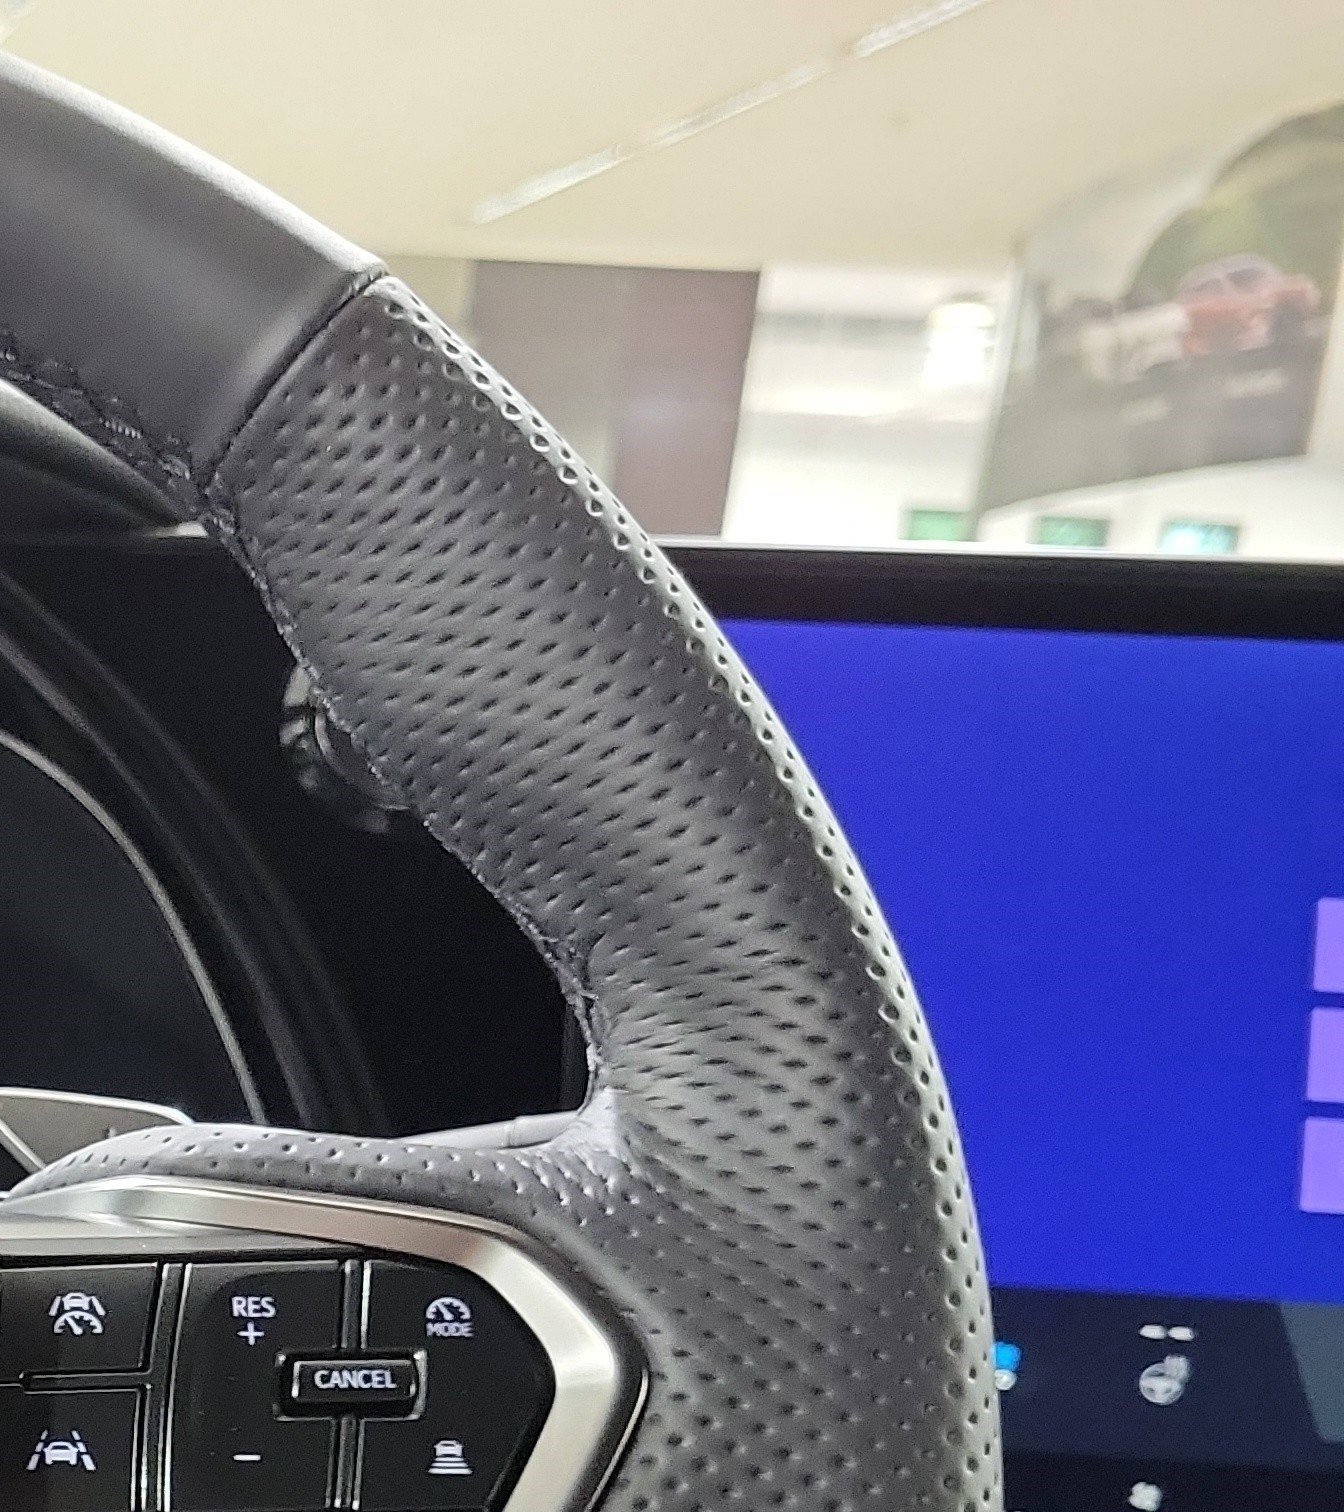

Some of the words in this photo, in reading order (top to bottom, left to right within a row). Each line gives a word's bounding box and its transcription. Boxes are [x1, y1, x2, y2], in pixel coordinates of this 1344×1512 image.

[232, 1296, 277, 1320] RES
[426, 1321, 474, 1339] MODE
[313, 1368, 398, 1390] CANCEL
